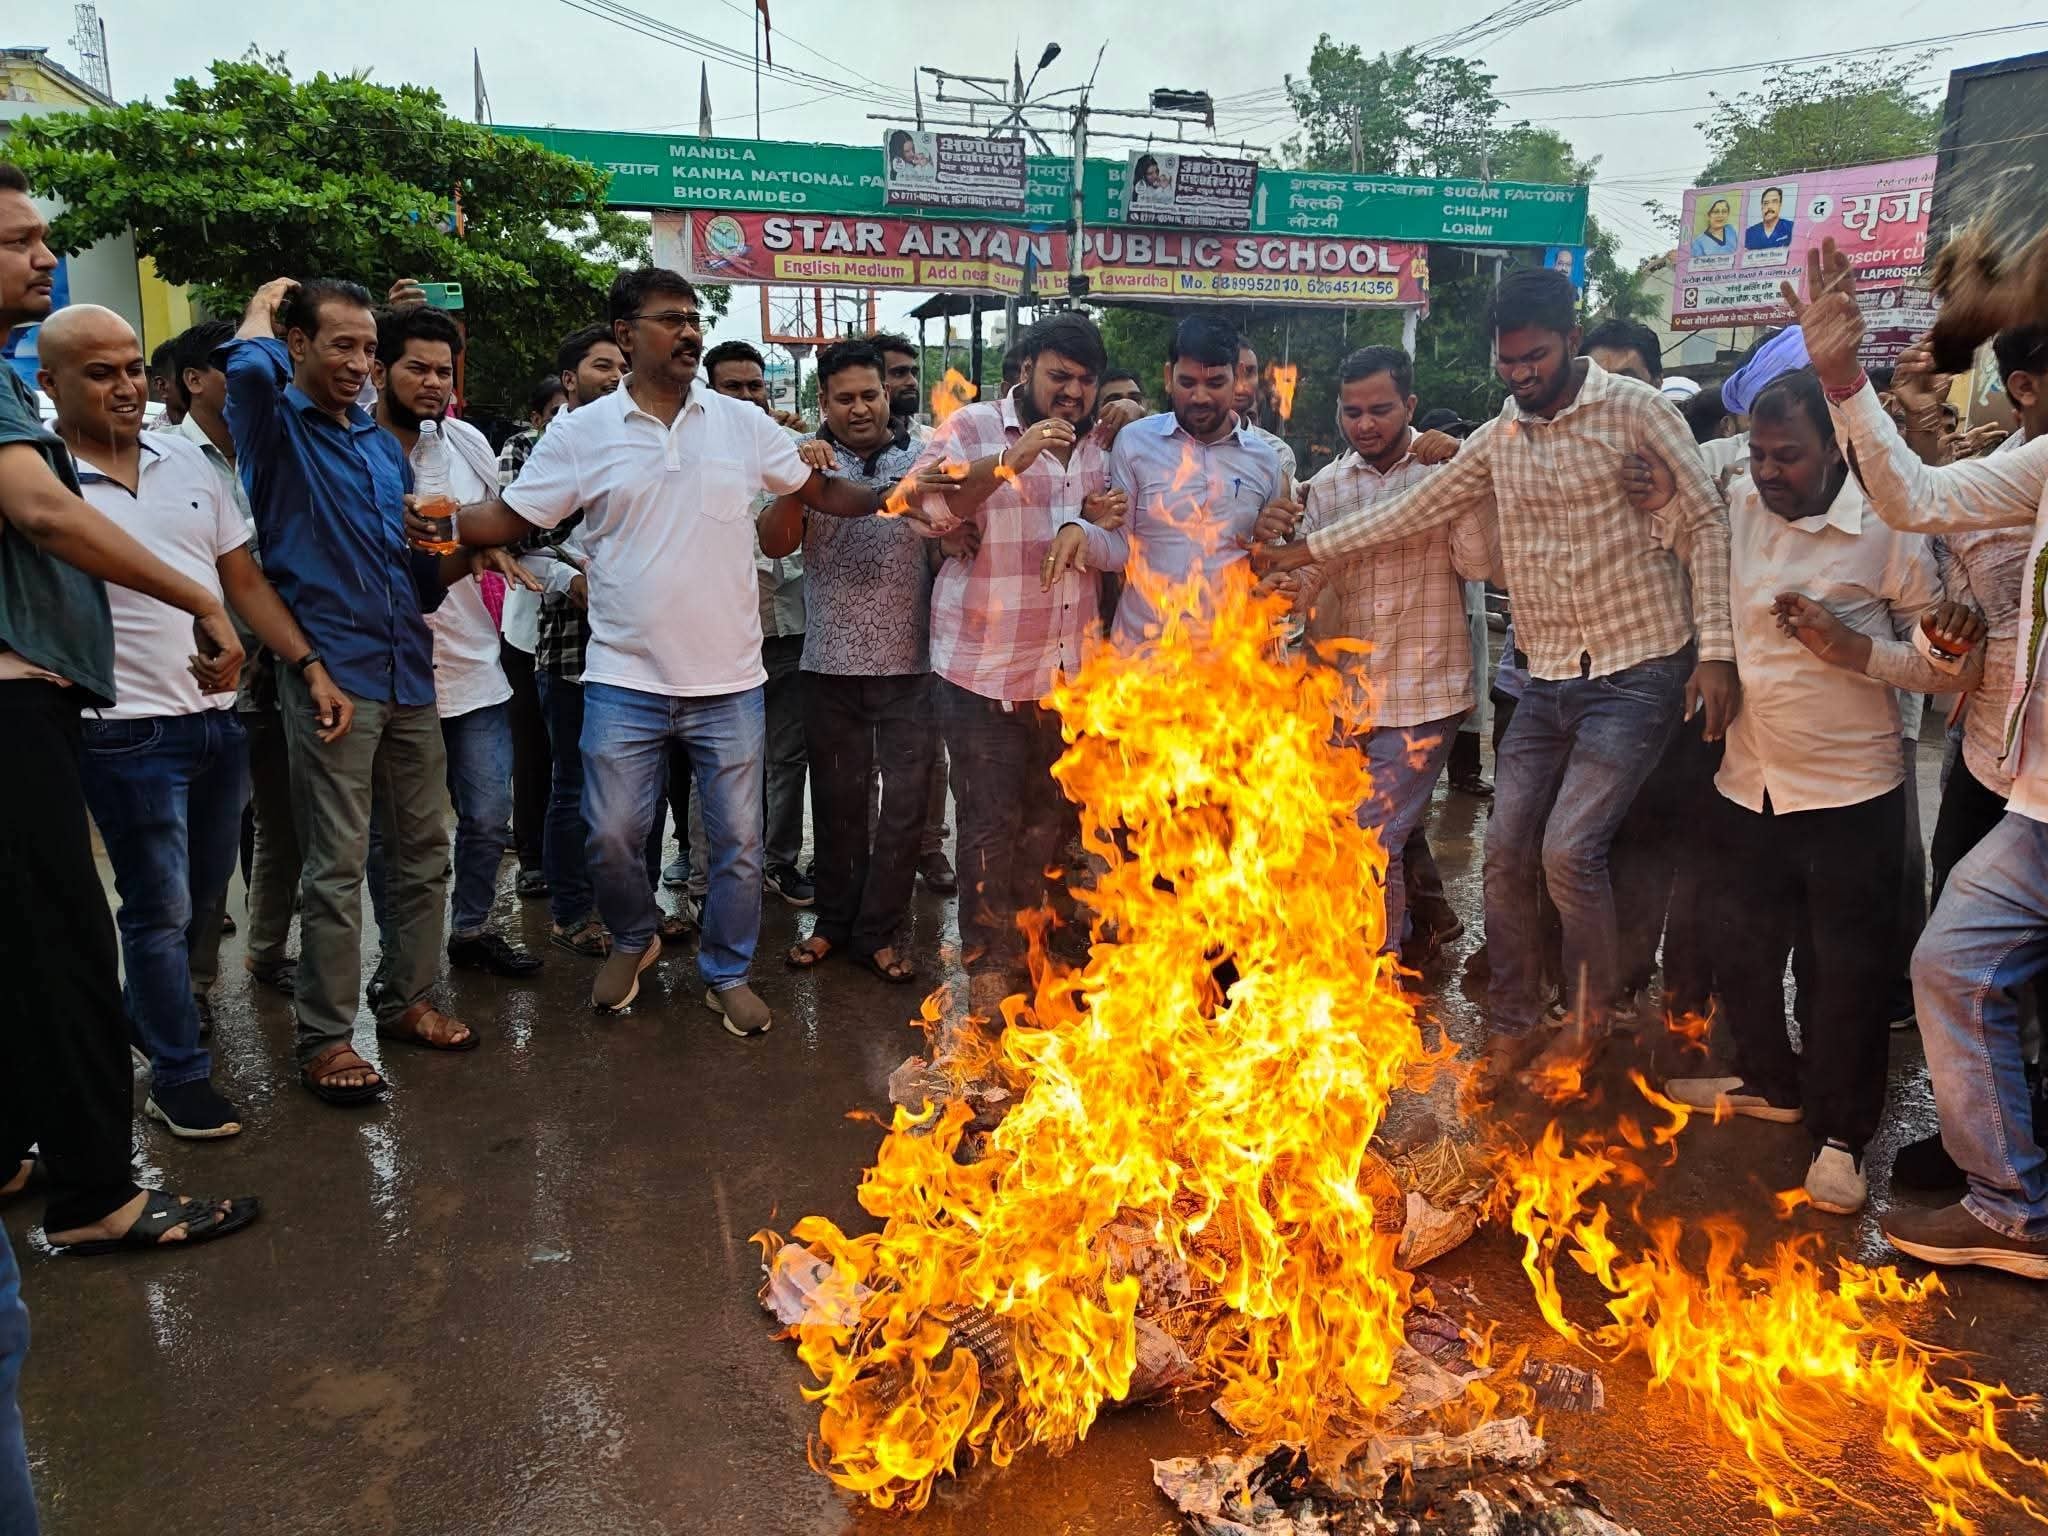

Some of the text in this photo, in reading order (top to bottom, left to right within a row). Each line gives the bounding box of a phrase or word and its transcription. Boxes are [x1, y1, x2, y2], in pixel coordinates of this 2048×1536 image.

[669, 145, 757, 161] MANDLA
[672, 166, 884, 188] KANHA NATIONAL PA
[673, 186, 806, 203] BHORAMDEO
[1443, 186, 1575, 203] SUGAR FACTORY
[1442, 205, 1507, 219] CHILPHI
[1442, 222, 1493, 236] LORMI
[763, 217, 886, 255] STAR
[898, 224, 1053, 267] ARYAN
[1234, 240, 1402, 274] SCHOOL
[1903, 246, 1926, 260] CLI
[783, 259, 904, 278] English Medium
[927, 265, 957, 280] Add
[1181, 274, 1206, 289] Mo.
